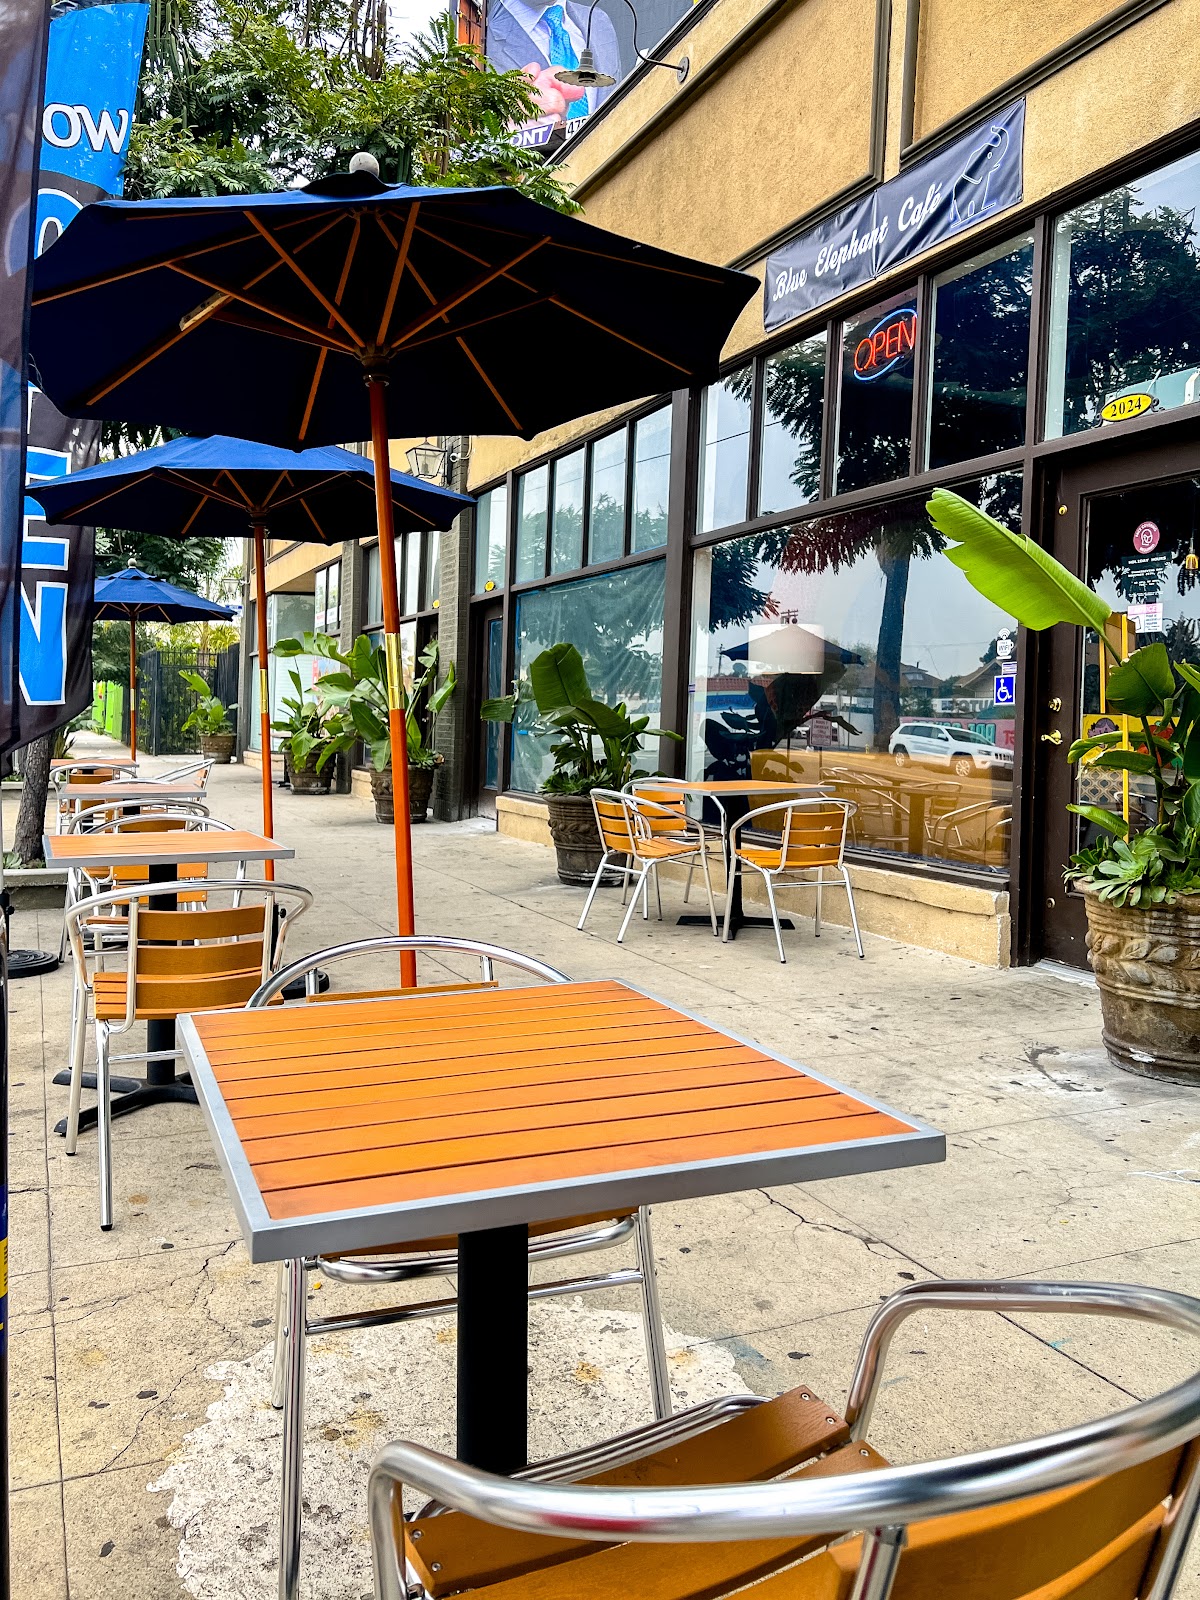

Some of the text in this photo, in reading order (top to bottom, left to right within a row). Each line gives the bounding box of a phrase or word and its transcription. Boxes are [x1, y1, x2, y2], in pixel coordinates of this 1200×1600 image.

[772, 183, 943, 301] Blue Elephant Café
[854, 315, 917, 371] OPEN
[1110, 397, 1141, 417] 2024
